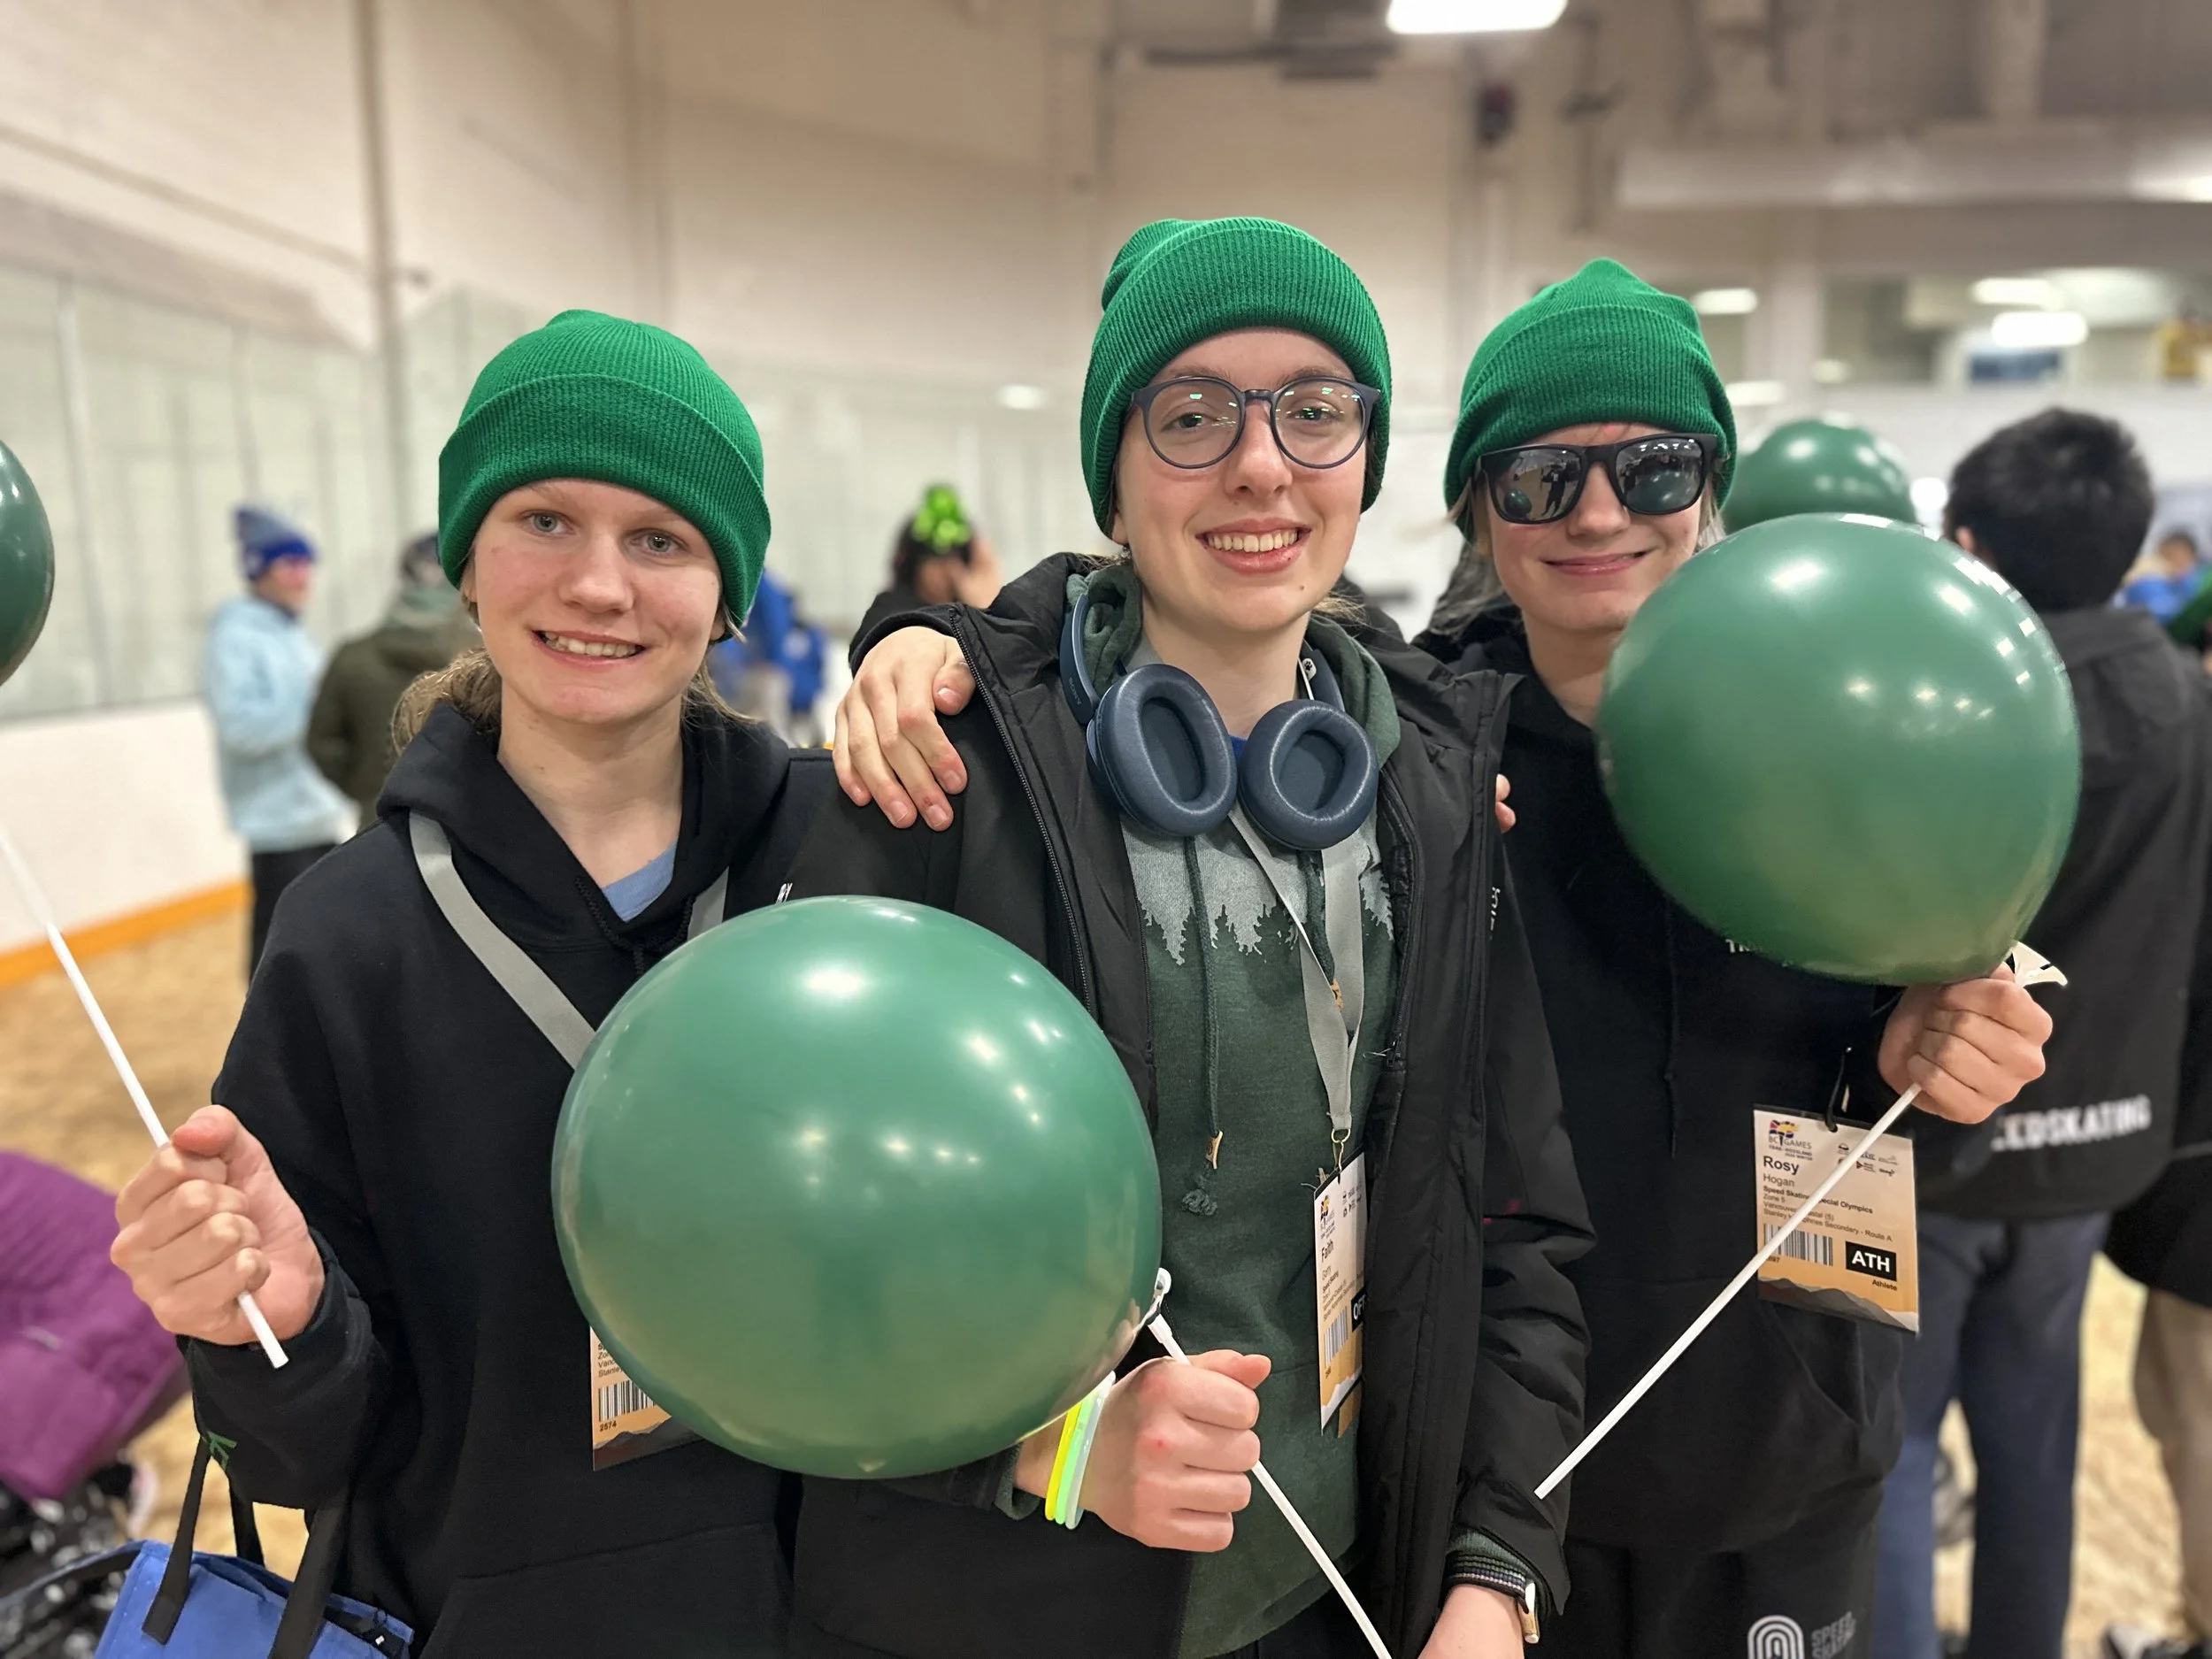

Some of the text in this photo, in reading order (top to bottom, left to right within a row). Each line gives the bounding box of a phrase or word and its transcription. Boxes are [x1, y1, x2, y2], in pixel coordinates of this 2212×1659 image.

[1991, 1094, 2154, 1151] EDSKATING
[1784, 1139, 1812, 1149] GAMES
[1763, 1156, 1799, 1175] Rosy
[1763, 1173, 1794, 1187] Hogan
[1763, 1193, 1779, 1202] Zone
[1763, 1186, 1785, 1195] Speed
[1840, 1201, 1873, 1214] Olympics
[1825, 1220, 1859, 1235] Secondary
[1865, 1229, 1885, 1240] Route
[1852, 1250, 1890, 1272] ATH
[1872, 1279, 1898, 1291] Athlete
[599, 1421, 617, 1432] 2574
